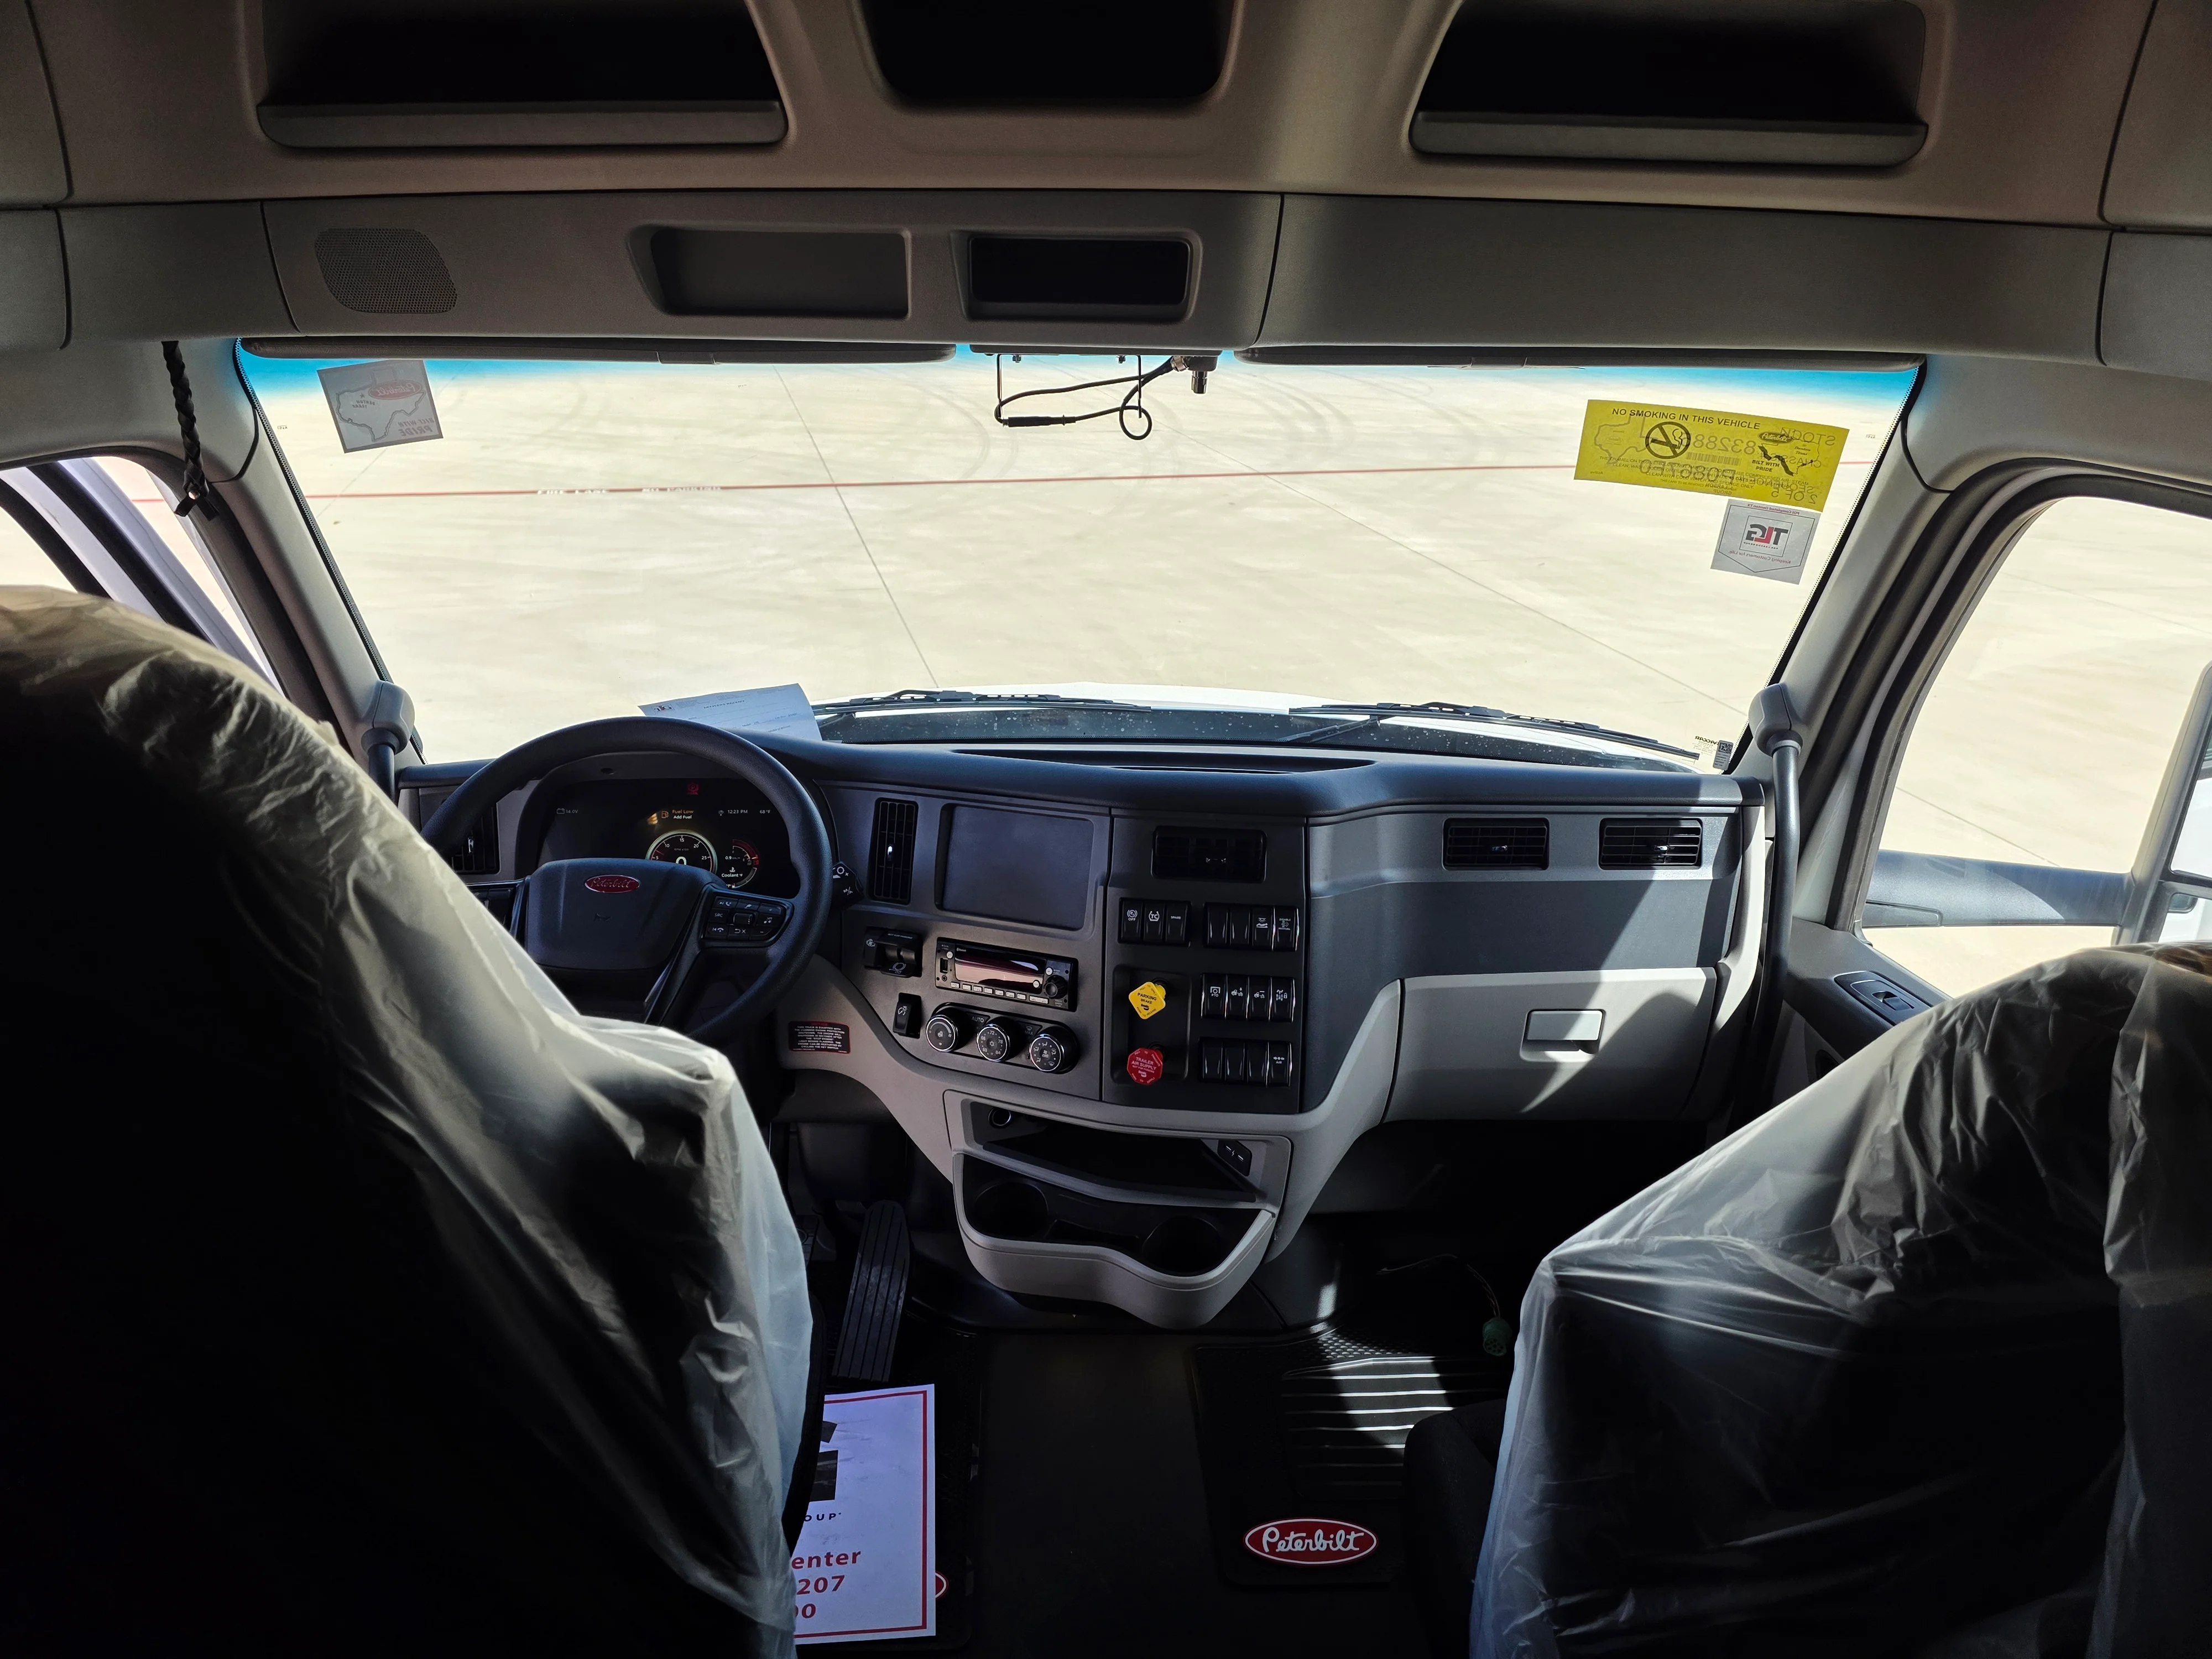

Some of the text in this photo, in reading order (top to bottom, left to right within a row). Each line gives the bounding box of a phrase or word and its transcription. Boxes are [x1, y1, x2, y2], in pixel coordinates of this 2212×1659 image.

[1629, 409, 1676, 420] SMOKING
[1692, 415, 1714, 424] THIS
[1717, 418, 1761, 430] VEHICLE
[1761, 433, 1791, 442] Peterbilt
[590, 877, 635, 888] Peterbilt
[1138, 992, 1157, 1001] PARKING
[1136, 1057, 1154, 1065] TRAILER
[1140, 1062, 1157, 1071] SUPPLY
[805, 1513, 836, 1521] OUP
[1262, 1526, 1364, 1553] Peterbilt
[791, 1551, 861, 1569] enter
